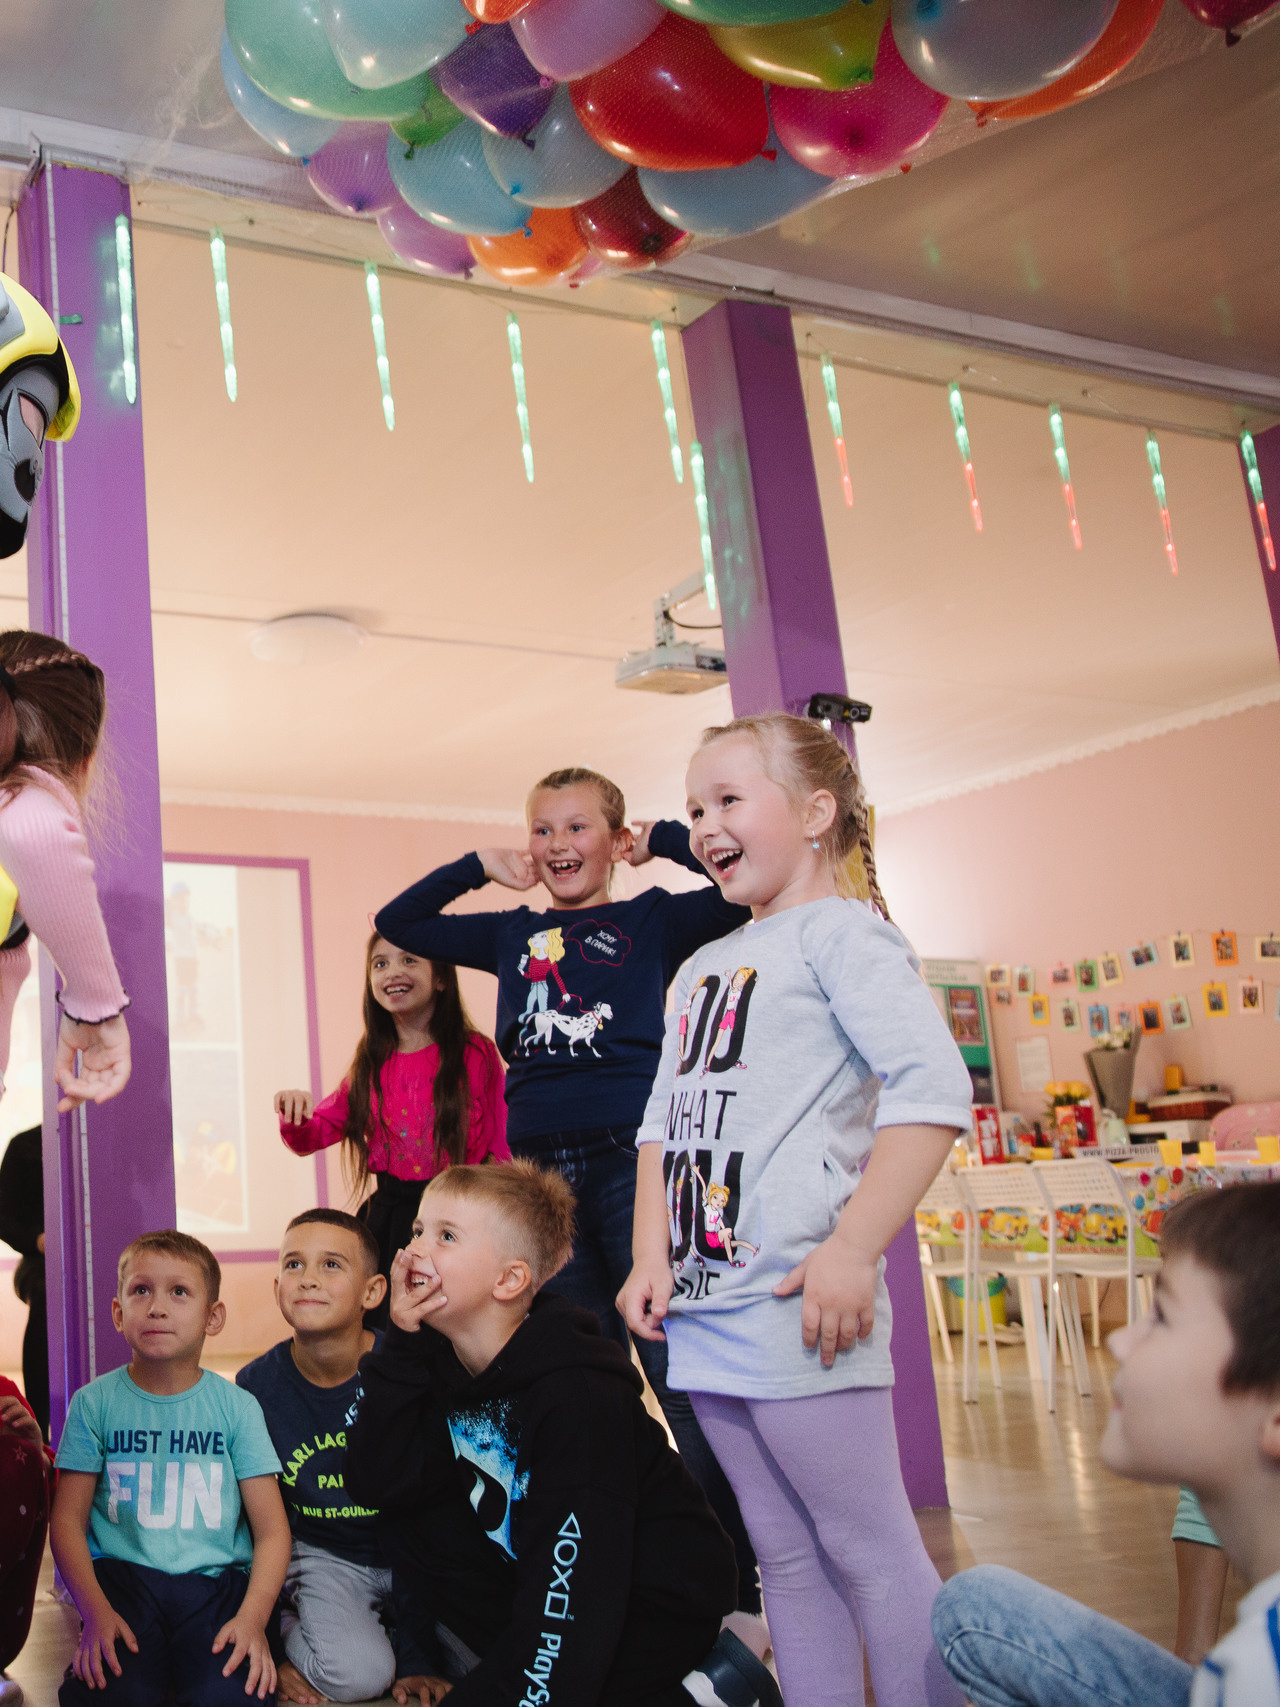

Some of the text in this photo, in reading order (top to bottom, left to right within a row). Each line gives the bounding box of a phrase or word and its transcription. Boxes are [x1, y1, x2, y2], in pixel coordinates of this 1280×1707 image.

[107, 1429, 225, 1455] JUST HAVE
[282, 1442, 315, 1488] KARL
[106, 1461, 223, 1530] FUN
[302, 1505, 323, 1519] RUE
[518, 1631, 562, 1707] PlayS
